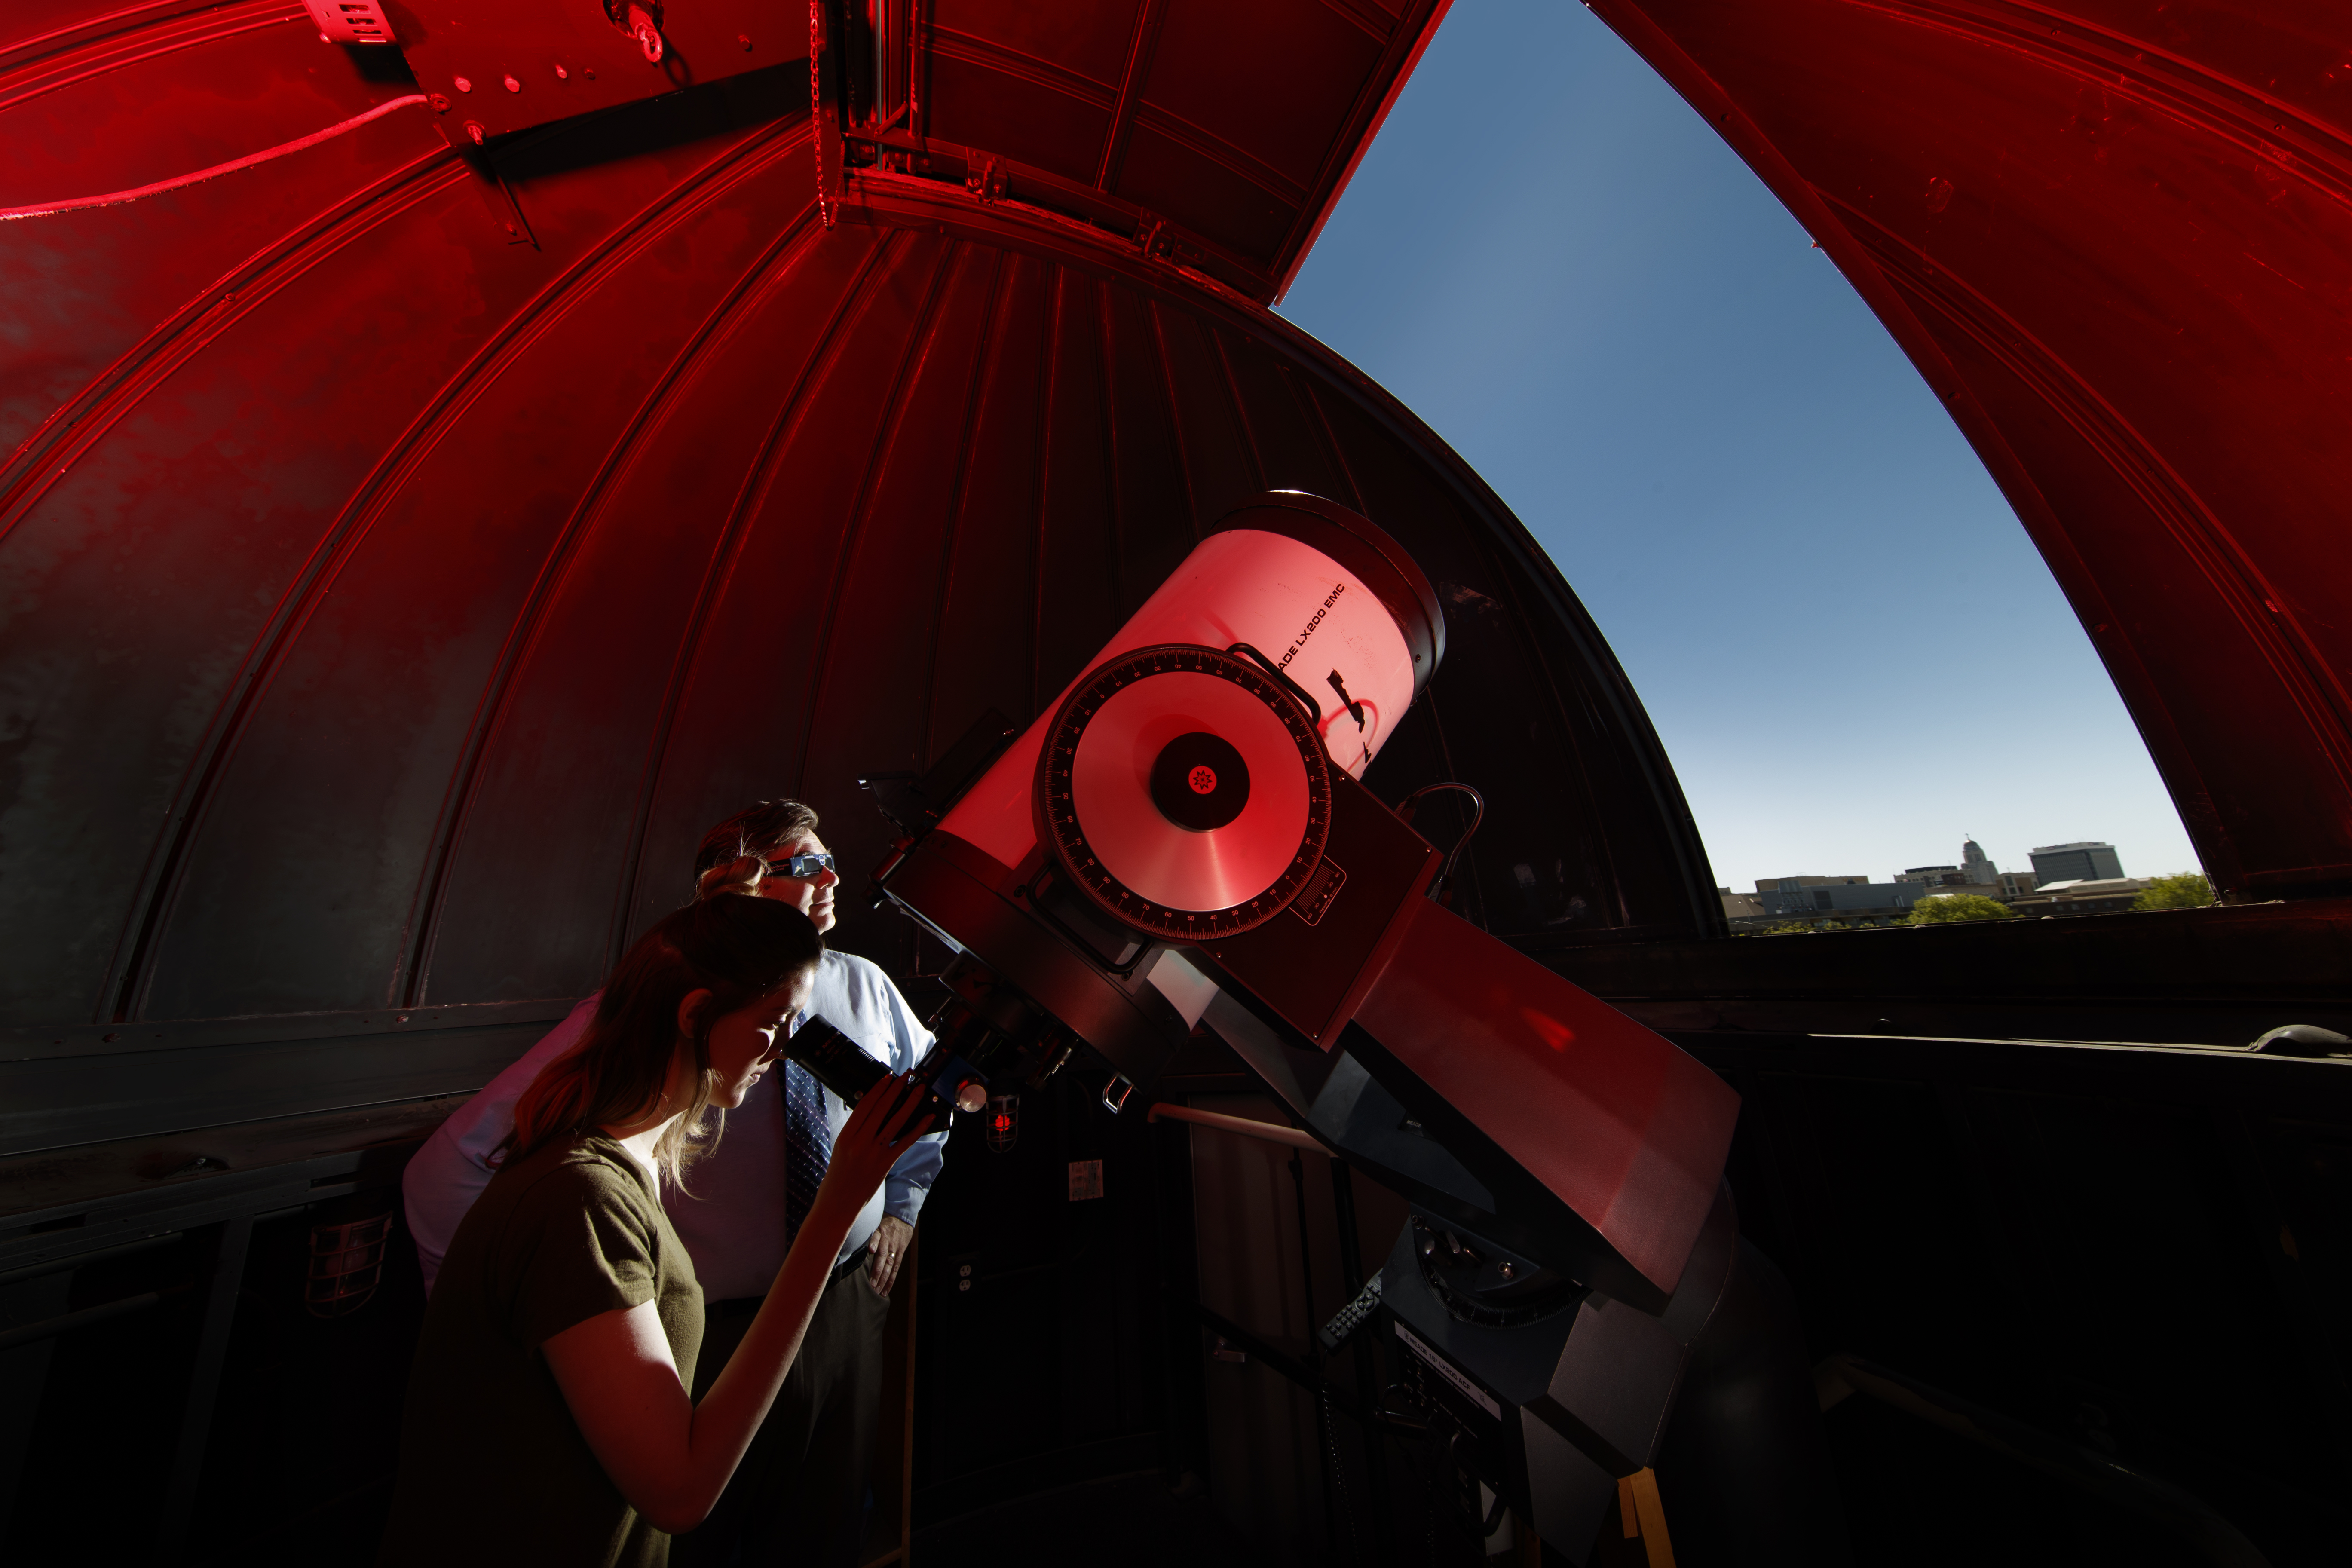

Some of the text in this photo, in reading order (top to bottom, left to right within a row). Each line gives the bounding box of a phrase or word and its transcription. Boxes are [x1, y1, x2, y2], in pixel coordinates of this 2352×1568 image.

[1278, 583, 1345, 671] ADE LX200 EMC
[822, 1031, 841, 1049] MEADE
[1410, 1337, 1470, 1390] MEADE 16" LX200-ACF
